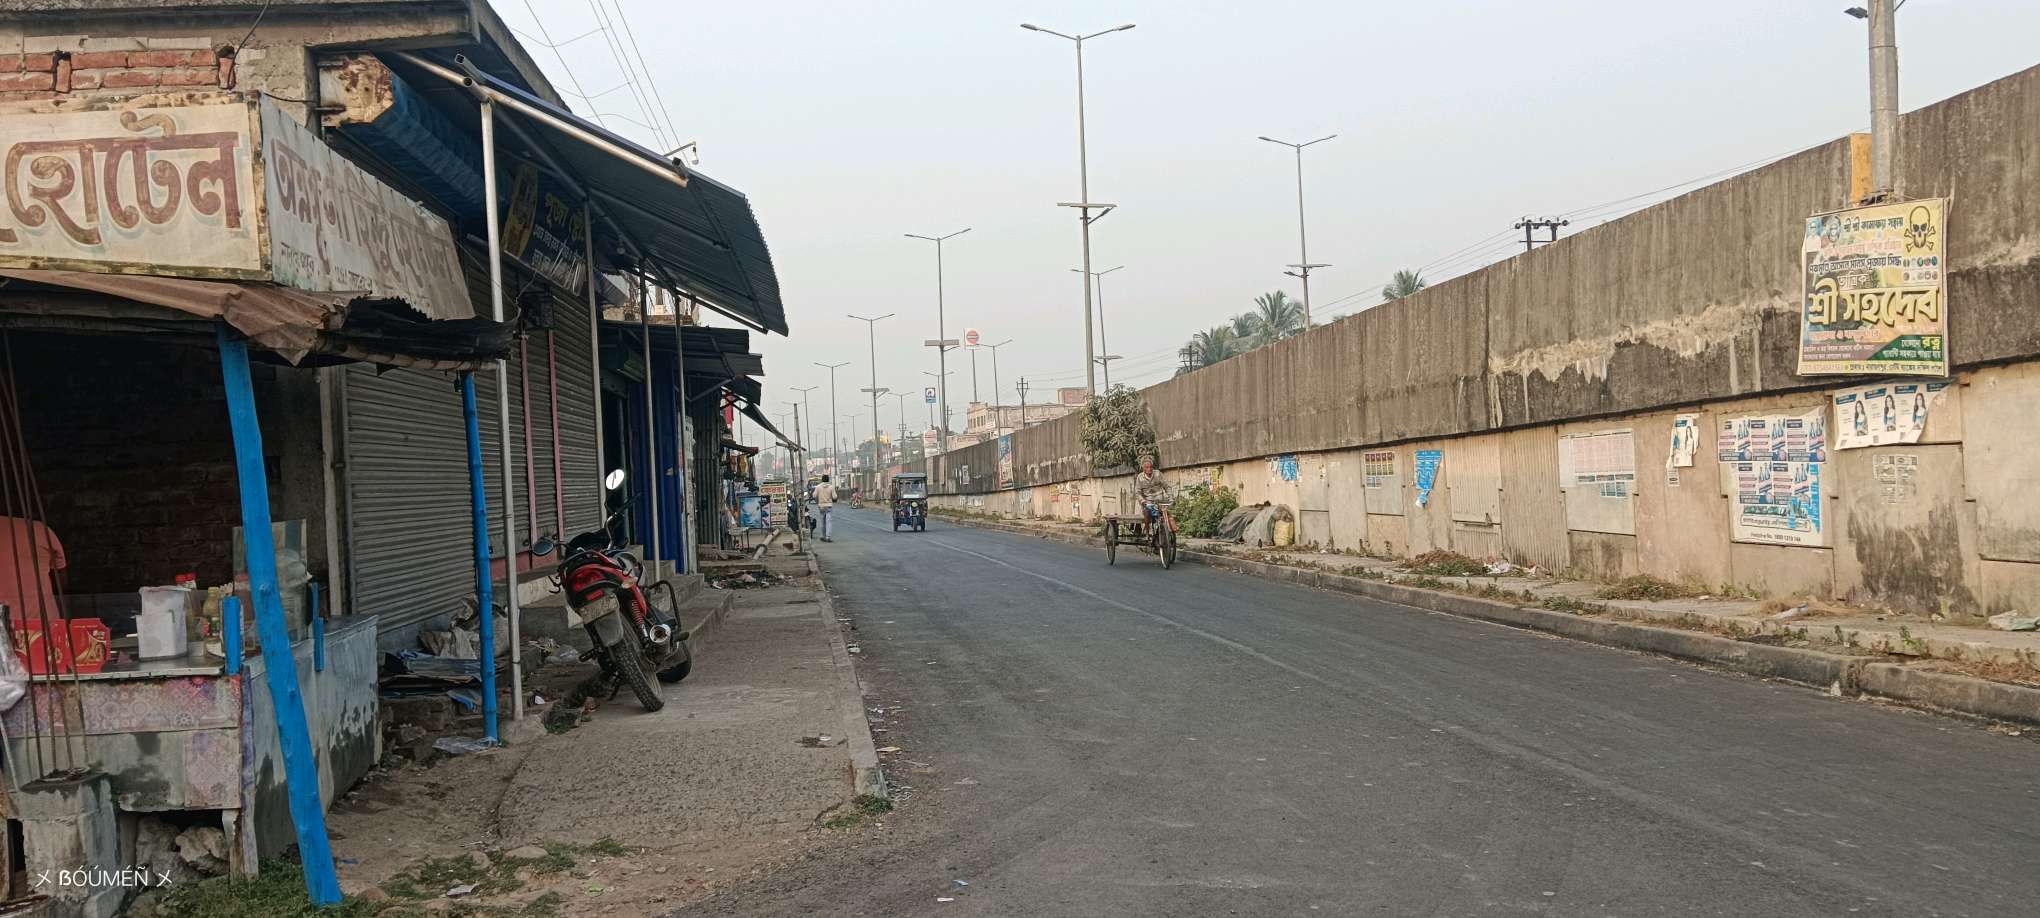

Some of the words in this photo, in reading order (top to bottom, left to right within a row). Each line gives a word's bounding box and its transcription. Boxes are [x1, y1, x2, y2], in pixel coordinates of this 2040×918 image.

[4, 111, 241, 246] হোটেল
[1808, 277, 1840, 326] শ্রী
[1842, 286, 1940, 328] সহদেব
